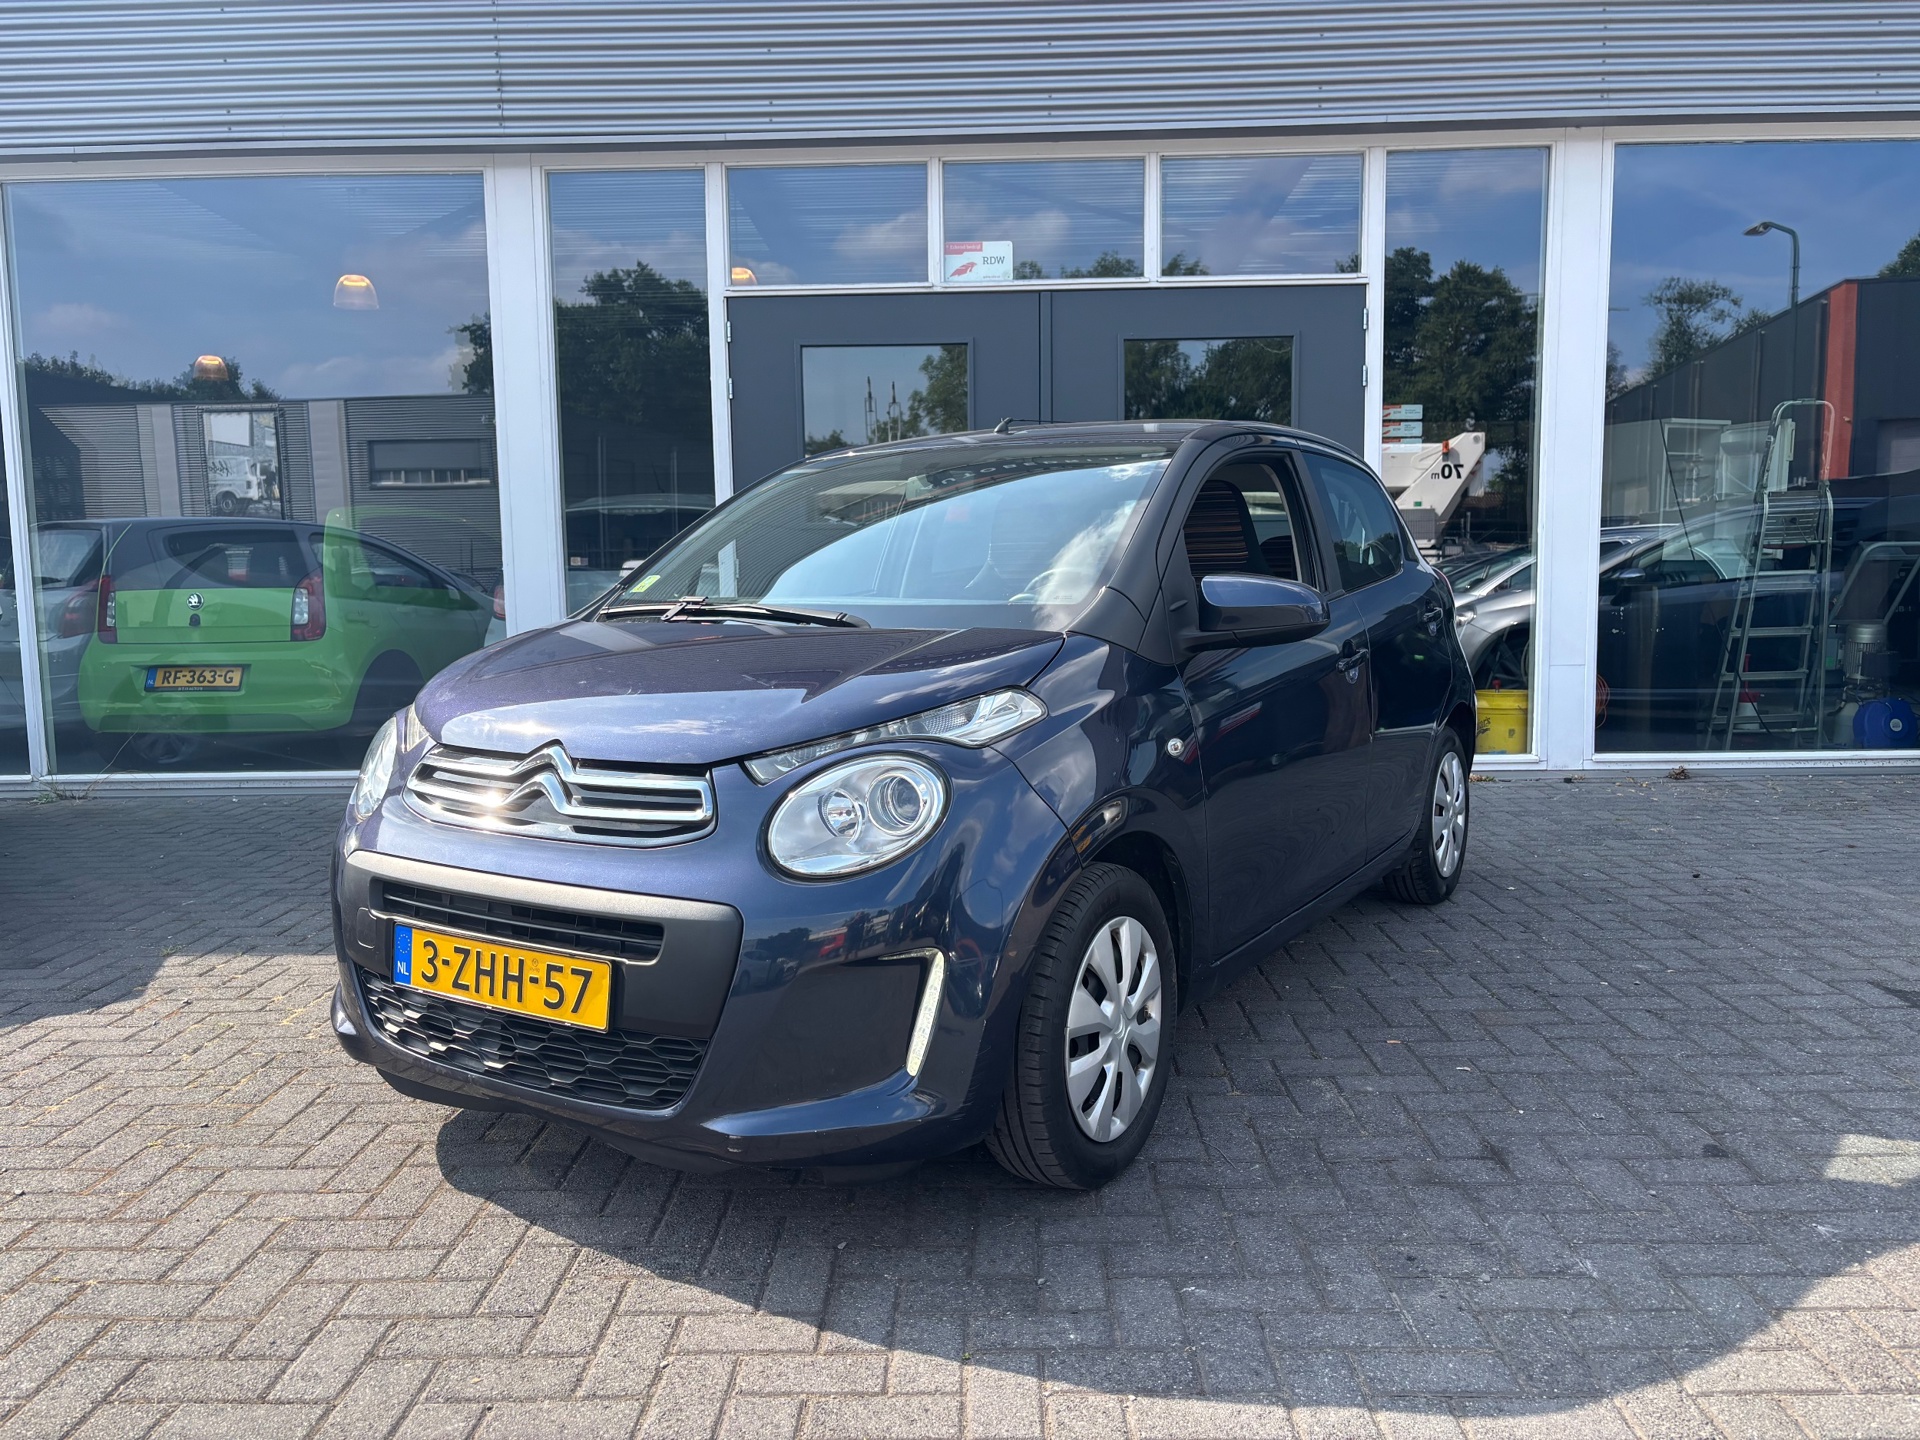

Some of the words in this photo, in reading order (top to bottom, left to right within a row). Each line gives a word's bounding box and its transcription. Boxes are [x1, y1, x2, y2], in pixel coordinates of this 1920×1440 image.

[982, 256, 1005, 265] RDW
[161, 669, 235, 685] RF-363-G
[397, 960, 409, 976] NL
[421, 939, 593, 1014] 3-ZHH-57
